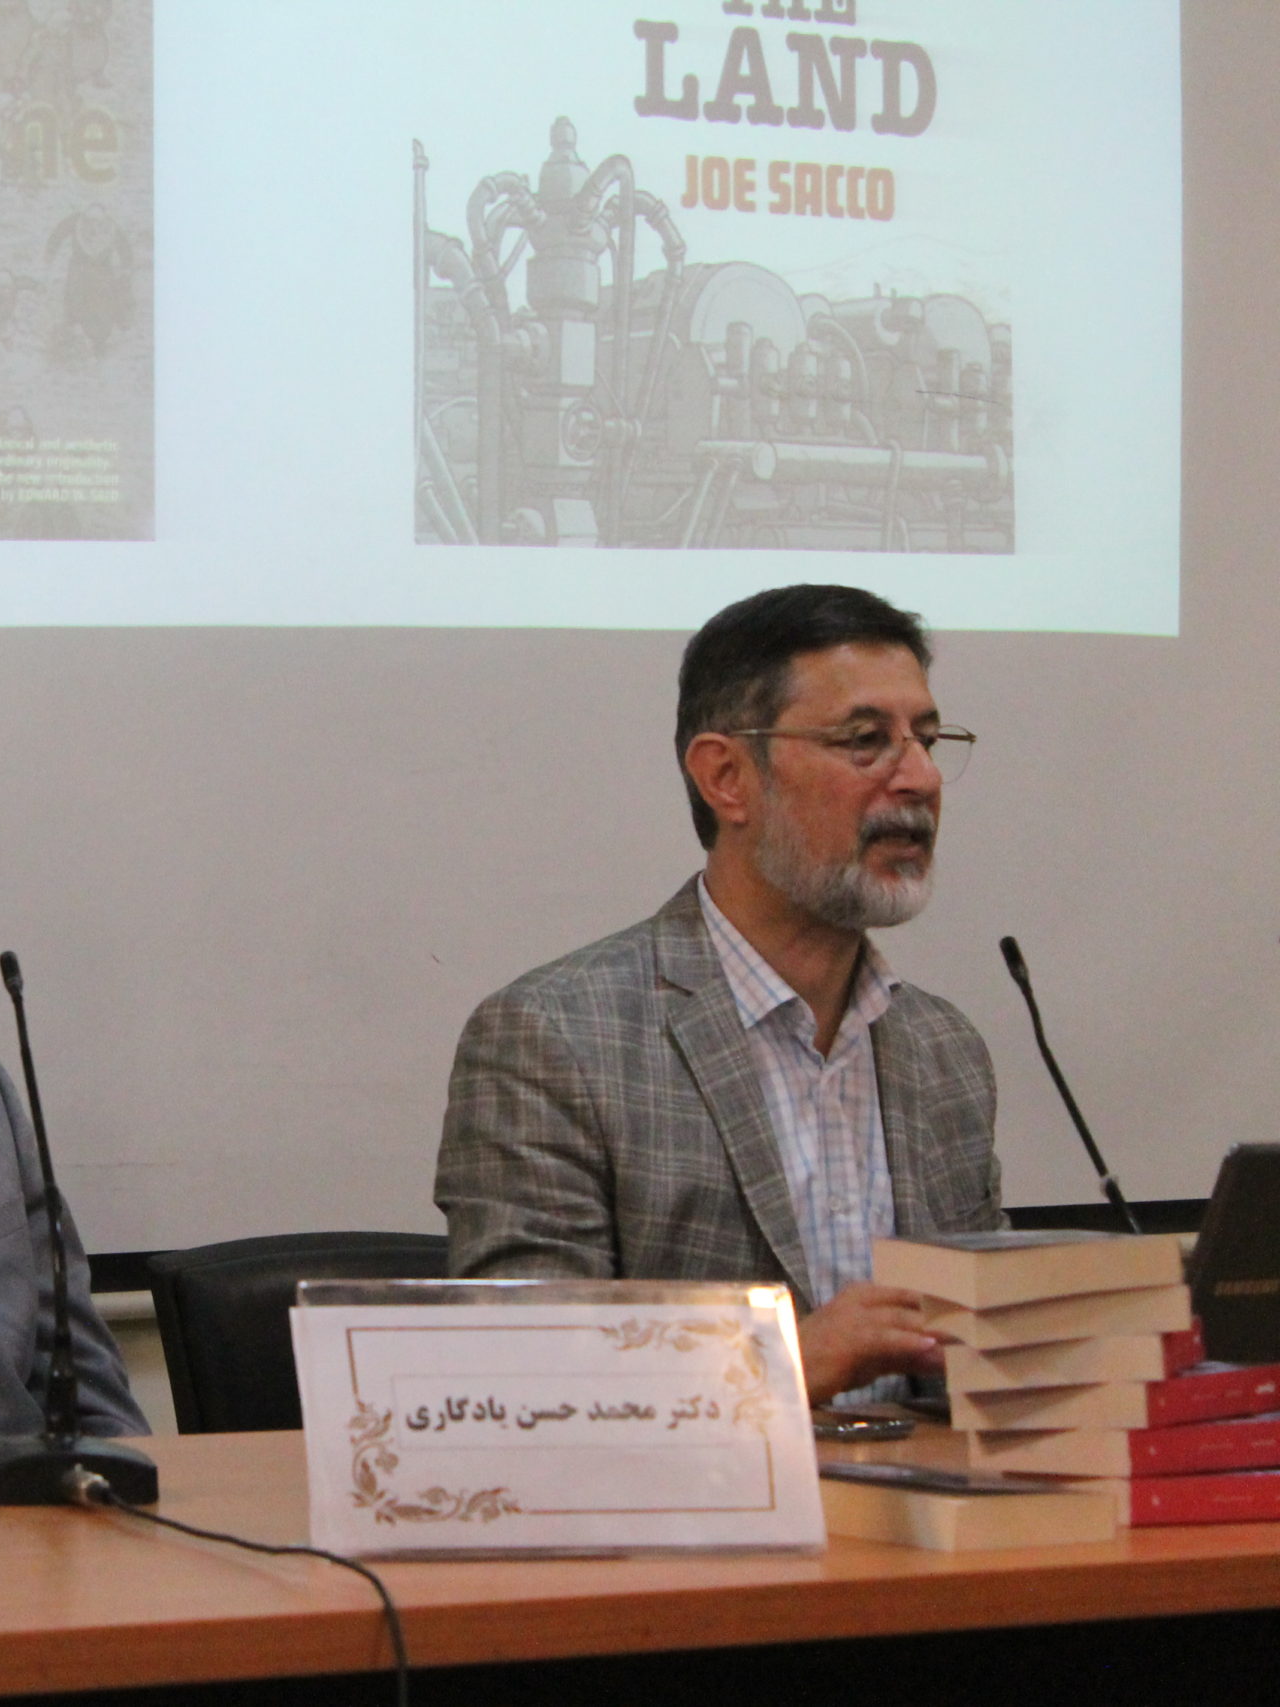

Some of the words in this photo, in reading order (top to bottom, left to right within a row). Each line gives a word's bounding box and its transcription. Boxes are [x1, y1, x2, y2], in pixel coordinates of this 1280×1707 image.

[633, 19, 937, 138] LAND
[681, 154, 757, 213] JOE
[768, 160, 895, 222] SACCO
[1, 488, 15, 503] by
[405, 1394, 507, 1432] یادگاری
[515, 1401, 578, 1430] حسن
[586, 1400, 657, 1423] محمد
[666, 1393, 720, 1431] دکتر
